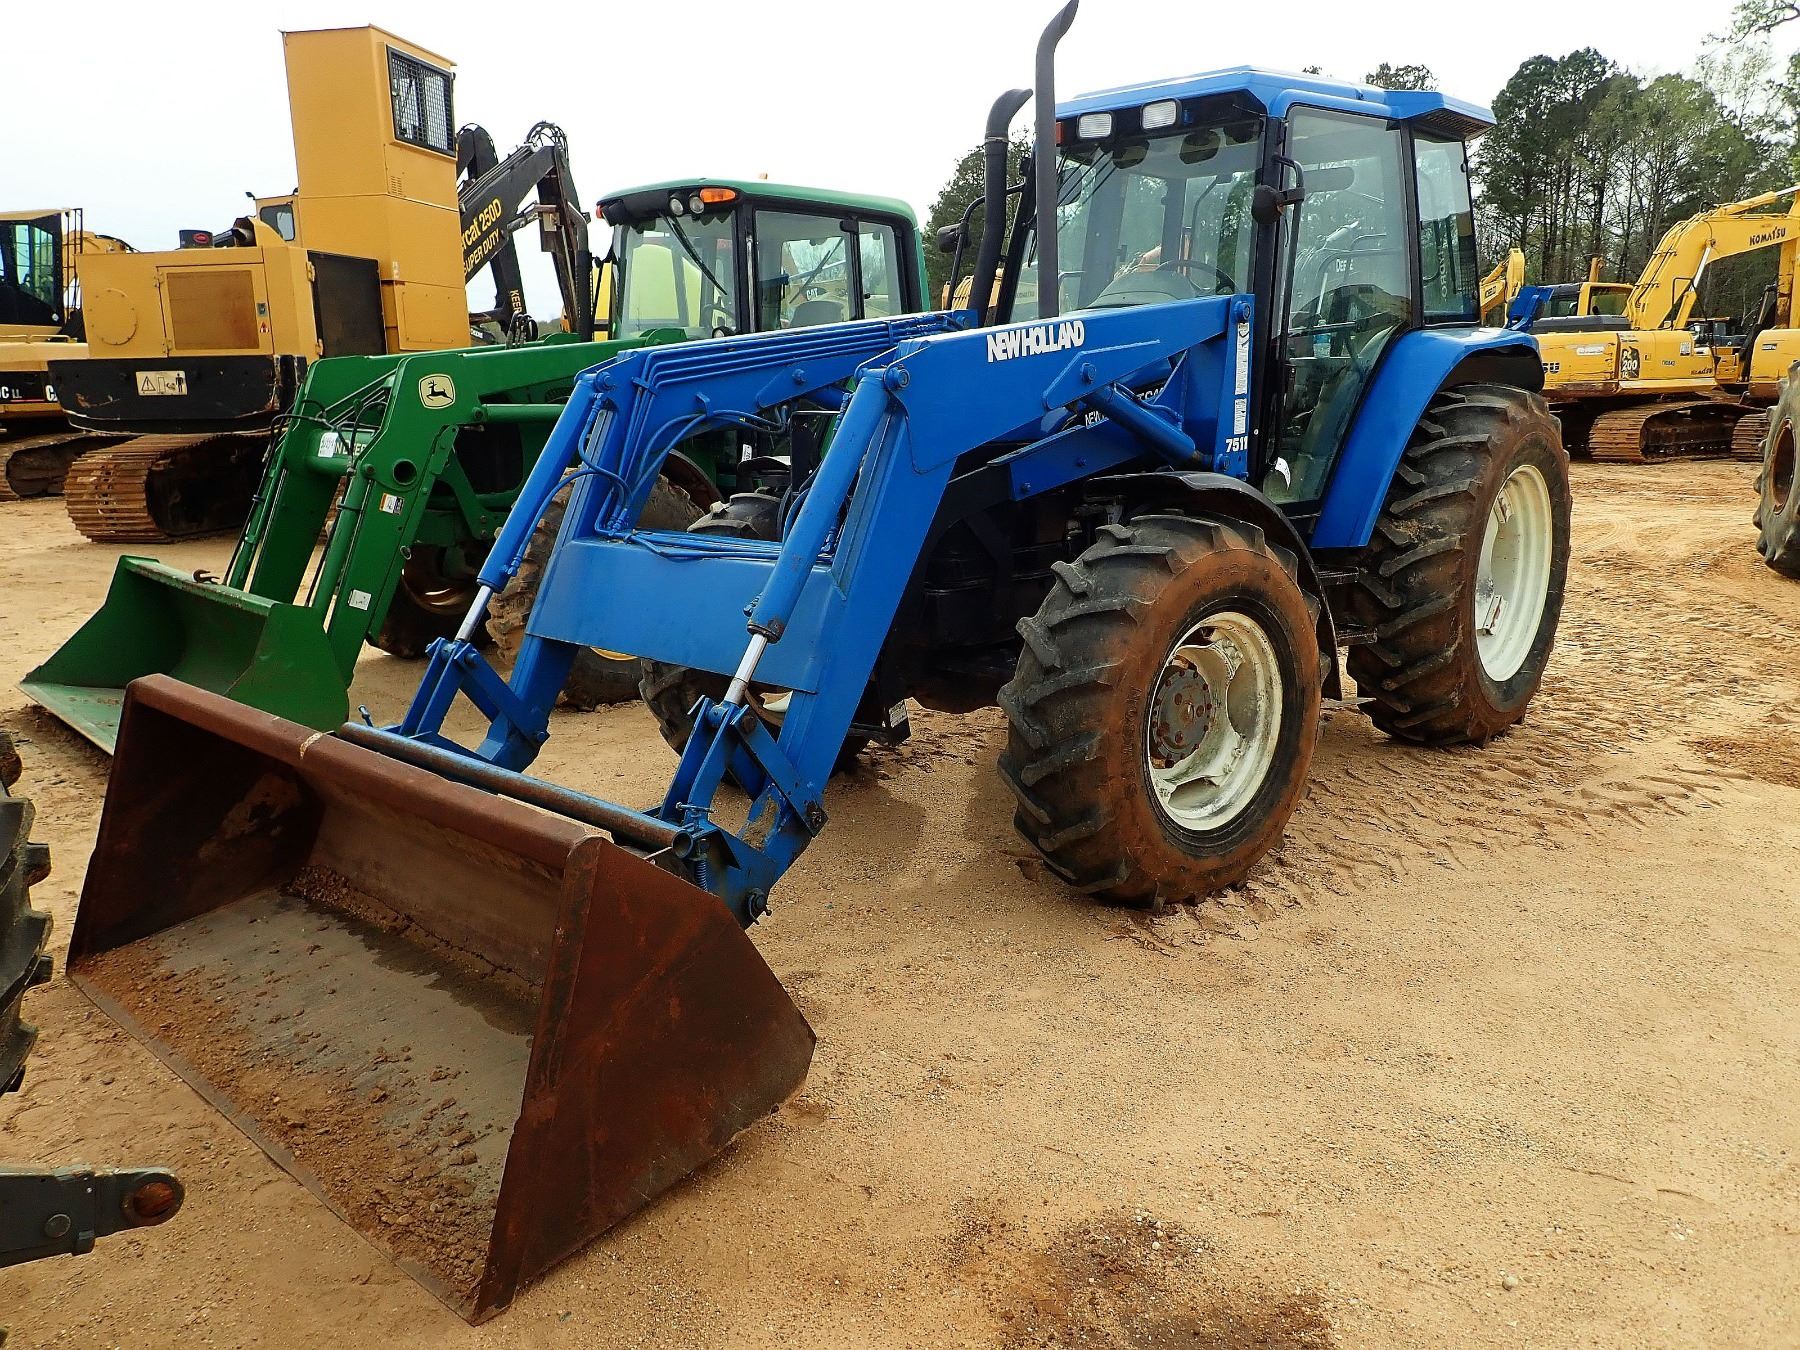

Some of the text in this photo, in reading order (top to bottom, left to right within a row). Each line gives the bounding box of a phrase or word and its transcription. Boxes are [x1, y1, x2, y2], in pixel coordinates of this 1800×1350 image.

[479, 198, 502, 232] 250D
[483, 228, 499, 255] DUTY
[1749, 226, 1786, 246] KOMATSU
[987, 320, 1085, 362] NEW HOLLAND
[1622, 359, 1638, 371] 200
[1225, 436, 1249, 452] 7511
